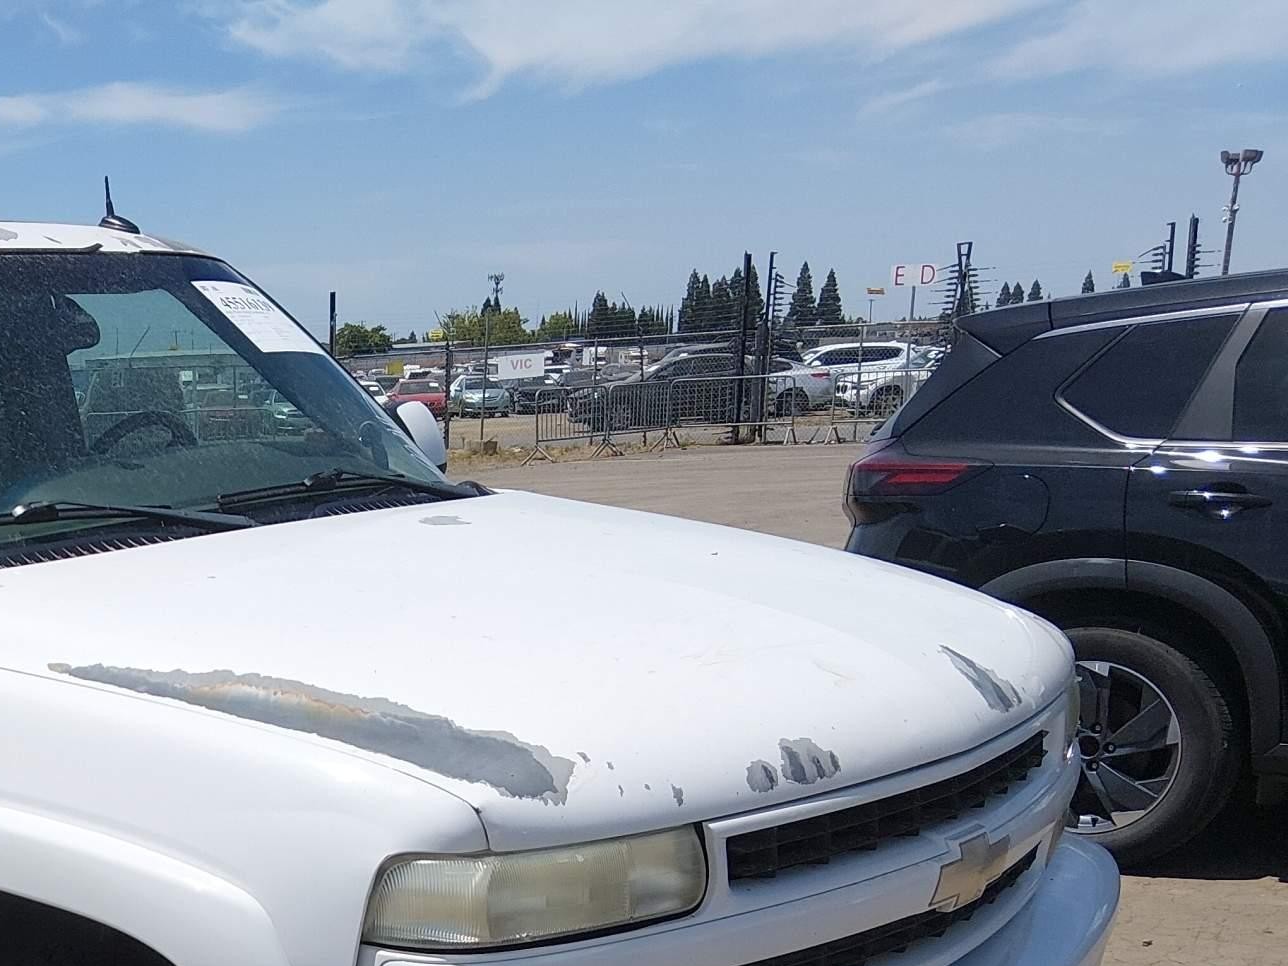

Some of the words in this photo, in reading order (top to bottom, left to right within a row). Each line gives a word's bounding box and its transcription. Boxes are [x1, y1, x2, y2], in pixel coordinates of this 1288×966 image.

[894, 265, 906, 286] E
[920, 264, 936, 285] D
[510, 358, 533, 370] VIC
